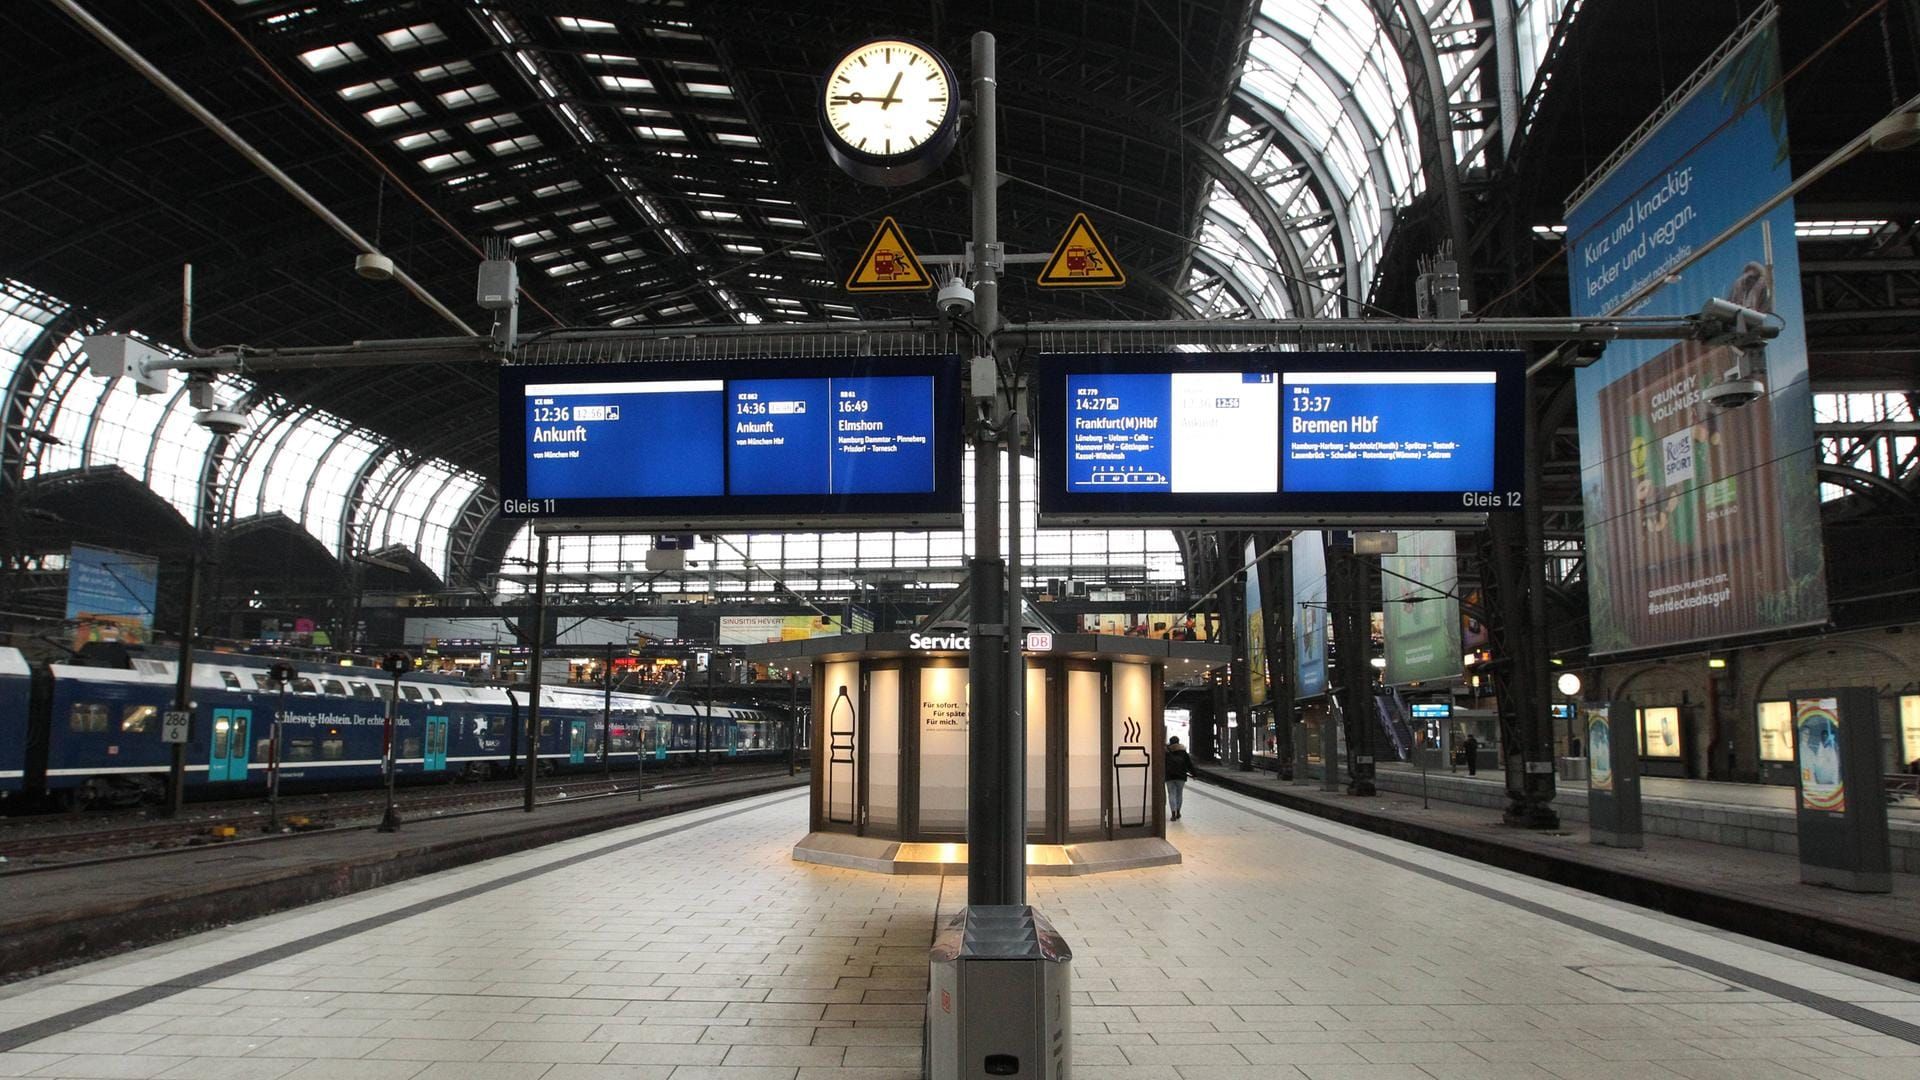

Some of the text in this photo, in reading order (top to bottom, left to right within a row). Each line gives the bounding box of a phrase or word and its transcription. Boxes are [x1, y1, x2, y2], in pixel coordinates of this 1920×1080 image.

[1585, 166, 1693, 267] Kurz und knackig:
[1587, 205, 1696, 298] lecker und vegan.
[1261, 374, 1270, 383] 11
[1651, 374, 1697, 408] CRUNCHY
[737, 403, 766, 415] 14:36
[839, 400, 868, 412] 16:49
[1076, 399, 1105, 410] 14:27
[1293, 397, 1331, 412] 13:37
[1651, 389, 1700, 424] VOLL-NUSS
[534, 407, 569, 422] 12:36
[736, 421, 774, 433] Ankunft
[839, 419, 883, 431] Elmshorn
[1075, 417, 1158, 430] Frankfurt(M)Hbf
[1292, 416, 1379, 433] Bremen Hbf
[533, 425, 587, 443] Ankunft
[1666, 456, 1691, 476] SPORT
[504, 499, 555, 513] Gleis 11
[1463, 491, 1521, 506] Gleis 12
[909, 632, 971, 649] Service
[165, 713, 186, 726] 286
[274, 711, 352, 727] Shleswig-Holstein.
[354, 714, 366, 726] Der
[367, 715, 384, 726] echte
[171, 728, 178, 739] 6
